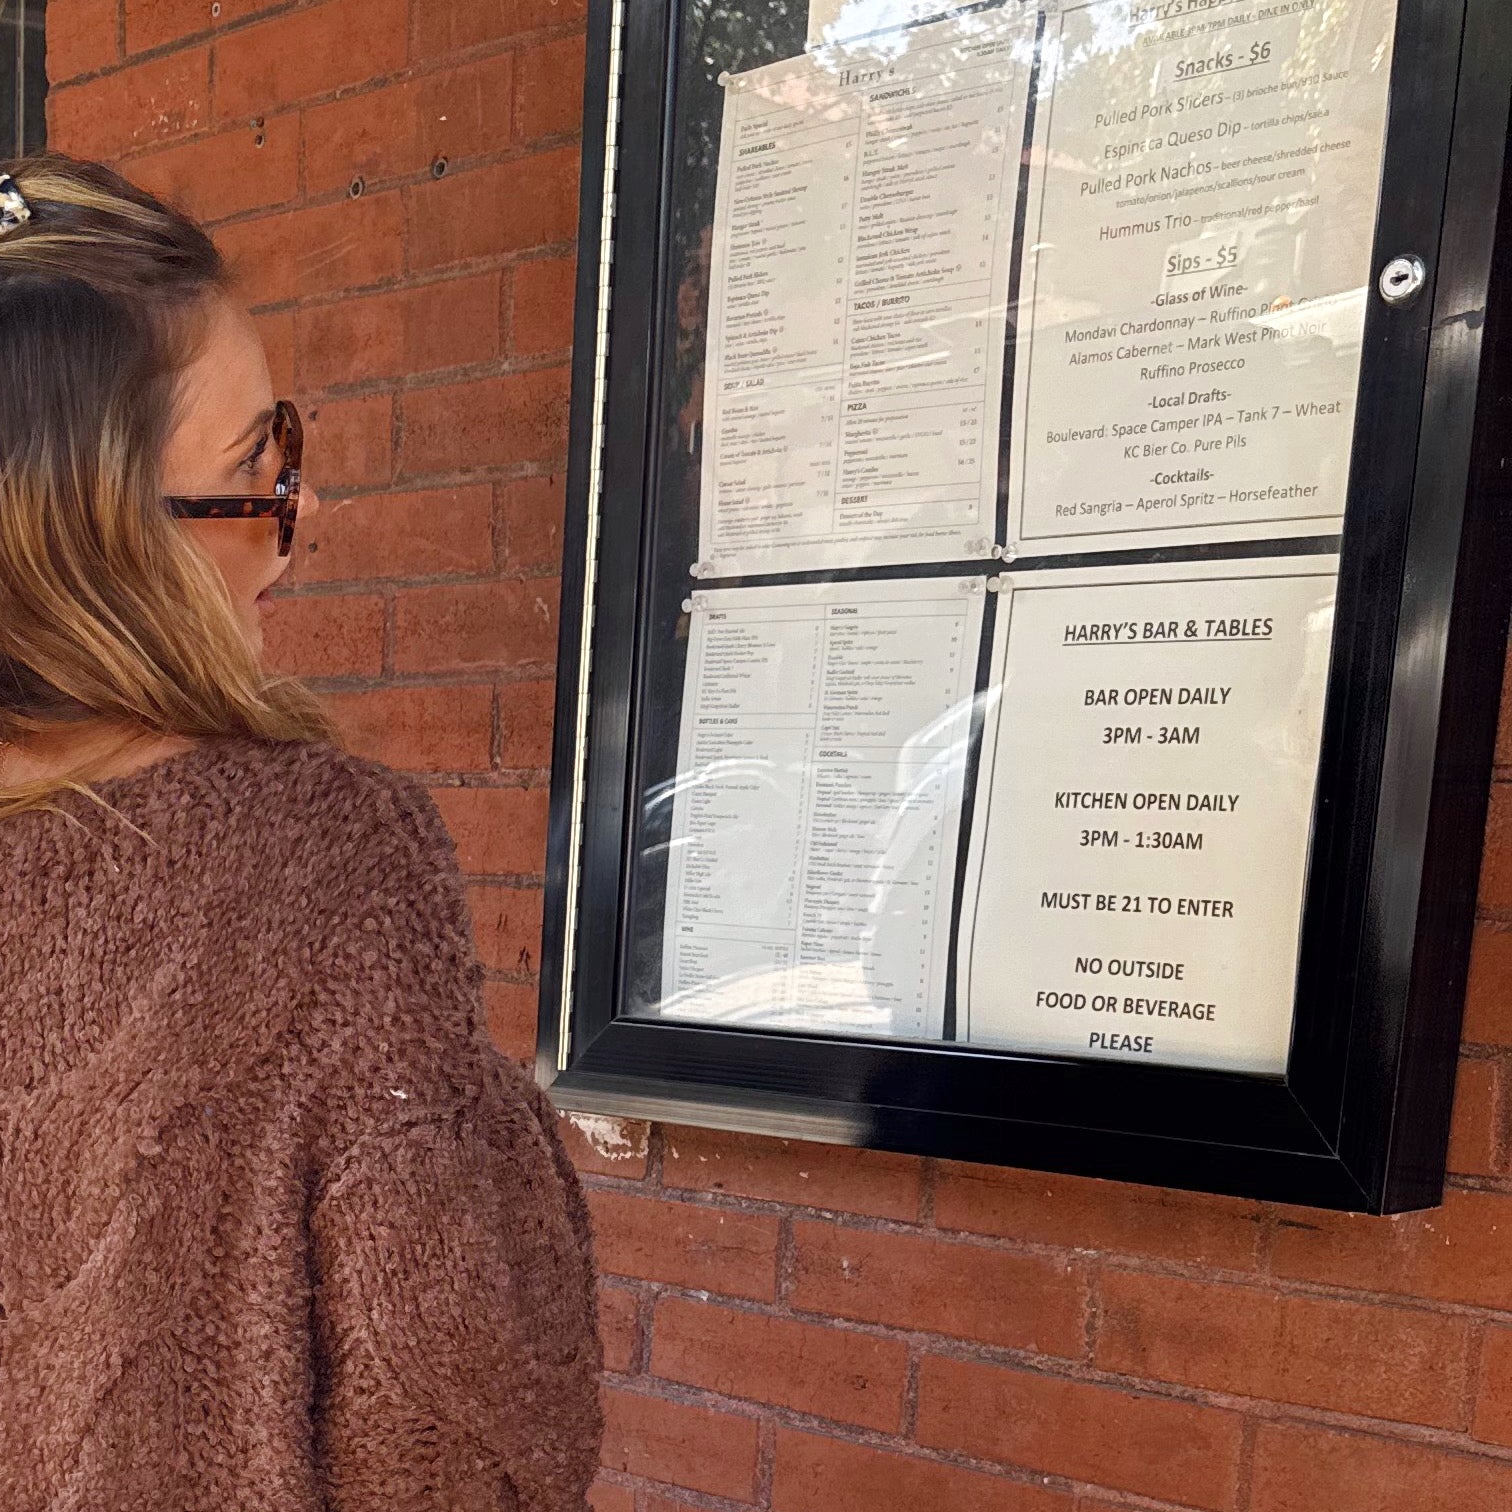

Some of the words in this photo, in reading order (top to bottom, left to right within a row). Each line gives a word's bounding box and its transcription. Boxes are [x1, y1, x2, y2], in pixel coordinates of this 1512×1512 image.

[1175, 52, 1232, 78] Snacks
[1250, 41, 1271, 65] $6
[839, 66, 895, 87] Harrys
[1095, 106, 1138, 128] Pulled
[1141, 102, 1172, 119] Pork
[1176, 91, 1224, 112] Sliders
[1247, 83, 1278, 98] brioche
[1104, 138, 1163, 160] Espinaca
[1168, 127, 1213, 147] Queso
[1217, 120, 1241, 138] Dip
[1251, 115, 1279, 131] tortilla
[1080, 174, 1122, 197] Pulled
[1126, 168, 1156, 188] Pork
[1161, 160, 1212, 182] Nachos
[1221, 158, 1240, 170] beer
[1243, 144, 1318, 167] cheese/shredded
[1320, 139, 1351, 153] cheese
[1278, 167, 1306, 180] cream
[1100, 219, 1161, 240] Hummus
[1165, 212, 1192, 230] Trio
[1167, 253, 1201, 274] Sips
[1216, 245, 1238, 267] $5
[854, 301, 875, 310] TACOS
[1151, 292, 1188, 307] -Glass
[1192, 287, 1207, 301] of
[1210, 284, 1248, 299] Wine-
[1065, 326, 1117, 343] Mondavi
[1120, 316, 1196, 336] Chardonnay
[1210, 306, 1256, 324] Ruffino
[1069, 351, 1113, 366] Alamos
[1117, 341, 1174, 360] Cabernet
[1188, 335, 1221, 351] Mark
[1225, 331, 1257, 345] West
[1261, 326, 1295, 341] Pinot
[1299, 321, 1327, 336] Noir
[1140, 364, 1185, 381] Ruffino
[1189, 358, 1245, 375] Prosecco
[847, 403, 867, 411] PIZZA
[1148, 392, 1185, 409] -Local
[1188, 388, 1232, 405] Drafts-
[1112, 423, 1148, 439] Space
[1151, 416, 1200, 433] Camper
[1203, 412, 1223, 427] IPA
[1237, 407, 1268, 423] Tank
[1272, 405, 1280, 420] 7
[1295, 400, 1341, 416] Wheat
[1124, 445, 1140, 459] KC
[1143, 443, 1168, 457] Bier
[1194, 439, 1222, 452] Pure
[1226, 434, 1247, 448] Pils
[1150, 467, 1214, 485] -Cocktails-
[1055, 503, 1077, 517] Red
[1080, 500, 1122, 516] Sangria
[1136, 494, 1178, 512] Aperol
[1180, 492, 1215, 509] Spritz
[1229, 483, 1318, 502] Horsefeather
[1064, 622, 1138, 641] HARRY'S
[1142, 621, 1179, 639] BAR
[1183, 619, 1198, 637] &
[1205, 618, 1273, 636] TABLES
[1084, 688, 1119, 706] BAR
[1124, 688, 1172, 705] OPEN
[1178, 687, 1231, 705] DAILY
[1102, 727, 1142, 744] 3PM
[1157, 726, 1200, 744] 3AM
[1054, 792, 1128, 809] KITCHEN
[1132, 793, 1181, 811] OPEN
[1186, 794, 1239, 812] DAILY
[1079, 830, 1118, 847] 3PM
[1135, 831, 1203, 850] 1:30AM
[1040, 892, 1091, 910] MUST
[1095, 894, 1117, 911] BE
[1121, 896, 1142, 913] 21
[1147, 896, 1172, 914] TO
[1177, 899, 1234, 918] ENTER
[1075, 957, 1103, 974] NO
[1107, 959, 1185, 980] OUTSIDE
[1036, 991, 1087, 1010] FOOD
[1091, 995, 1118, 1013] OR
[1122, 997, 1216, 1021] BEVERAGE
[1089, 1032, 1154, 1053] PLEASE
